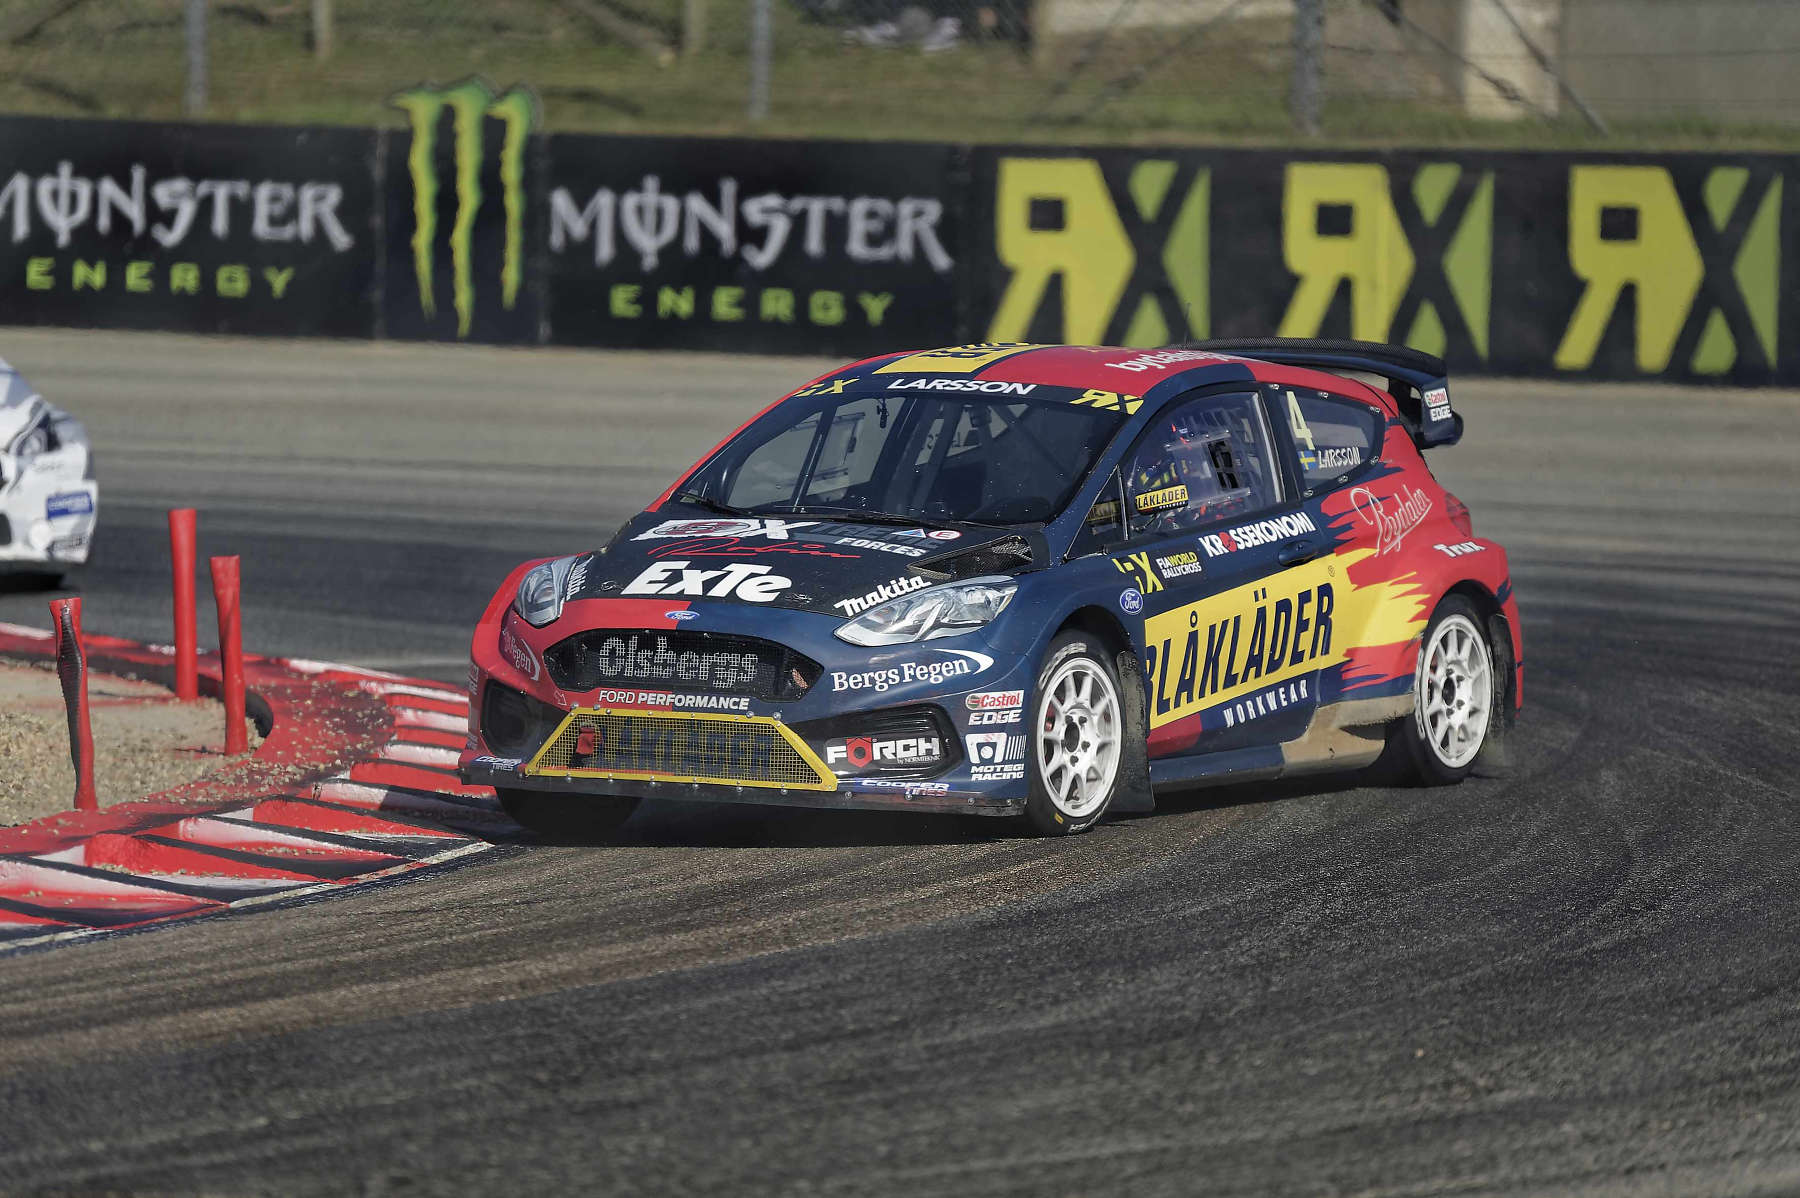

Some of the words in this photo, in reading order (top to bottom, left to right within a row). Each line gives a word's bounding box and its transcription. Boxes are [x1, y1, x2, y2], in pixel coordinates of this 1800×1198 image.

[0, 160, 353, 252] MONSTER
[549, 174, 954, 273] MONSTER
[26, 257, 295, 299] ENERGY
[608, 283, 895, 327] ENERGY
[887, 379, 1037, 395] LARSSON
[1286, 391, 1315, 450] 4
[1318, 447, 1360, 468] LARSSON
[834, 537, 927, 557] FORCES
[1161, 561, 1202, 579] RALLYCROSS
[599, 690, 635, 704] FORD
[638, 692, 749, 710] PERFORMANCE
[980, 693, 1021, 708] Castrol
[1223, 680, 1308, 727] WORKWEAR
[968, 709, 1022, 726] EDGE
[970, 764, 1024, 773] MOTEGI
[971, 772, 1024, 781] RACING
[862, 779, 950, 792] COOPER
